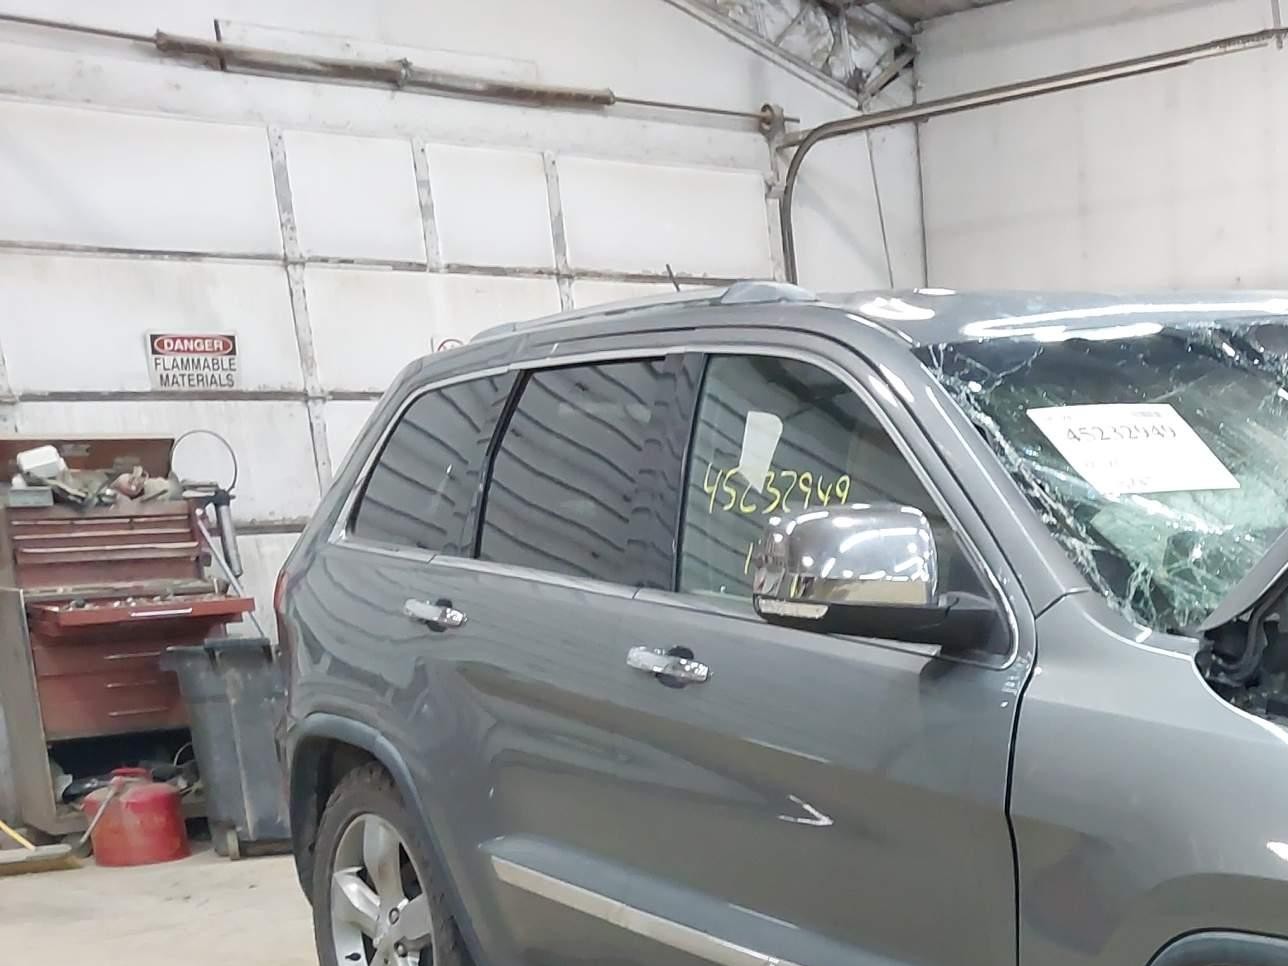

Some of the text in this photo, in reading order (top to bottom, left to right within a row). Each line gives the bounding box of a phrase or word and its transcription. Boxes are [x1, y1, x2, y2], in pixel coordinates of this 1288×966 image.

[163, 338, 224, 352] DANGER
[154, 357, 237, 372] FLAMMABLE
[159, 373, 235, 388] MATERIALS
